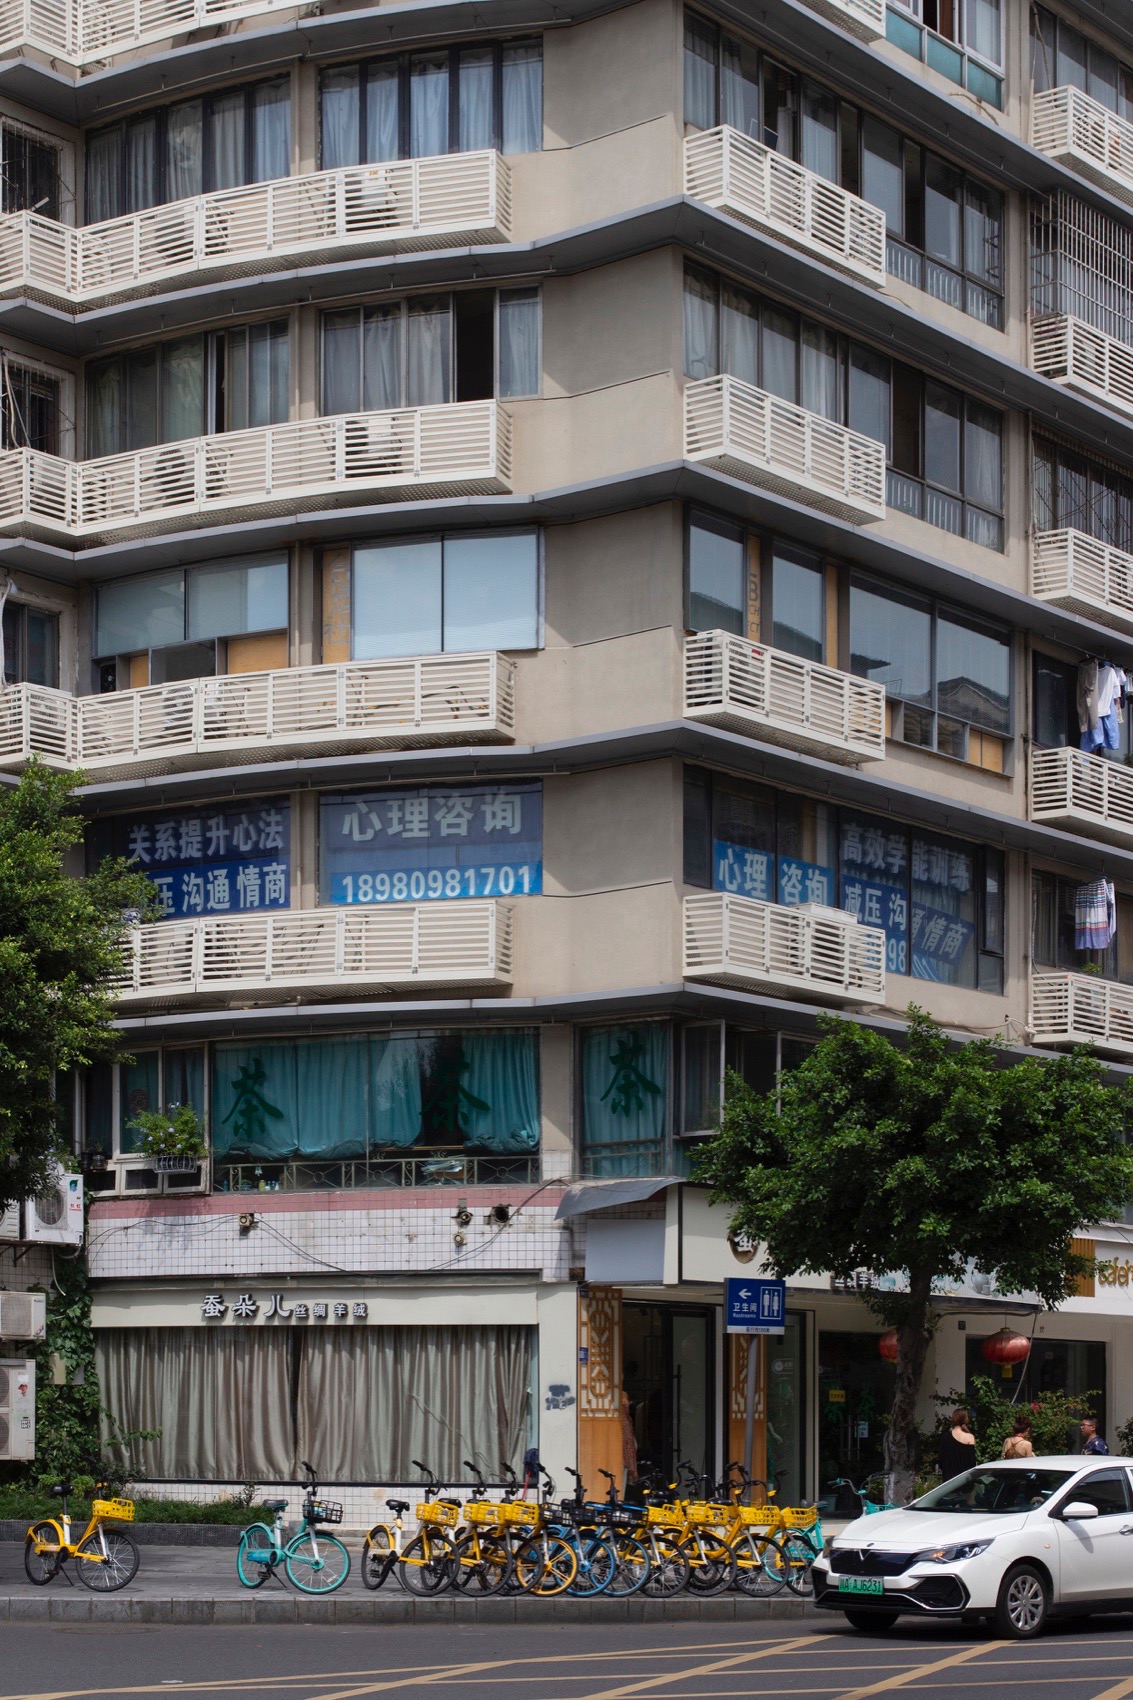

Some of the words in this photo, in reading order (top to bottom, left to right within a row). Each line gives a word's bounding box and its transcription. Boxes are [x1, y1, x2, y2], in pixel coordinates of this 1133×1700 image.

[128, 809, 284, 863] 关系提升心法
[342, 792, 522, 841] 心理咨询
[154, 862, 287, 914] 压沟通情商
[342, 865, 530, 904] 18980981701
[719, 848, 828, 905] 心理咨询
[221, 1057, 285, 1139] 茶
[600, 1031, 661, 1118] 茶
[733, 1302, 757, 1312] 卫生间
